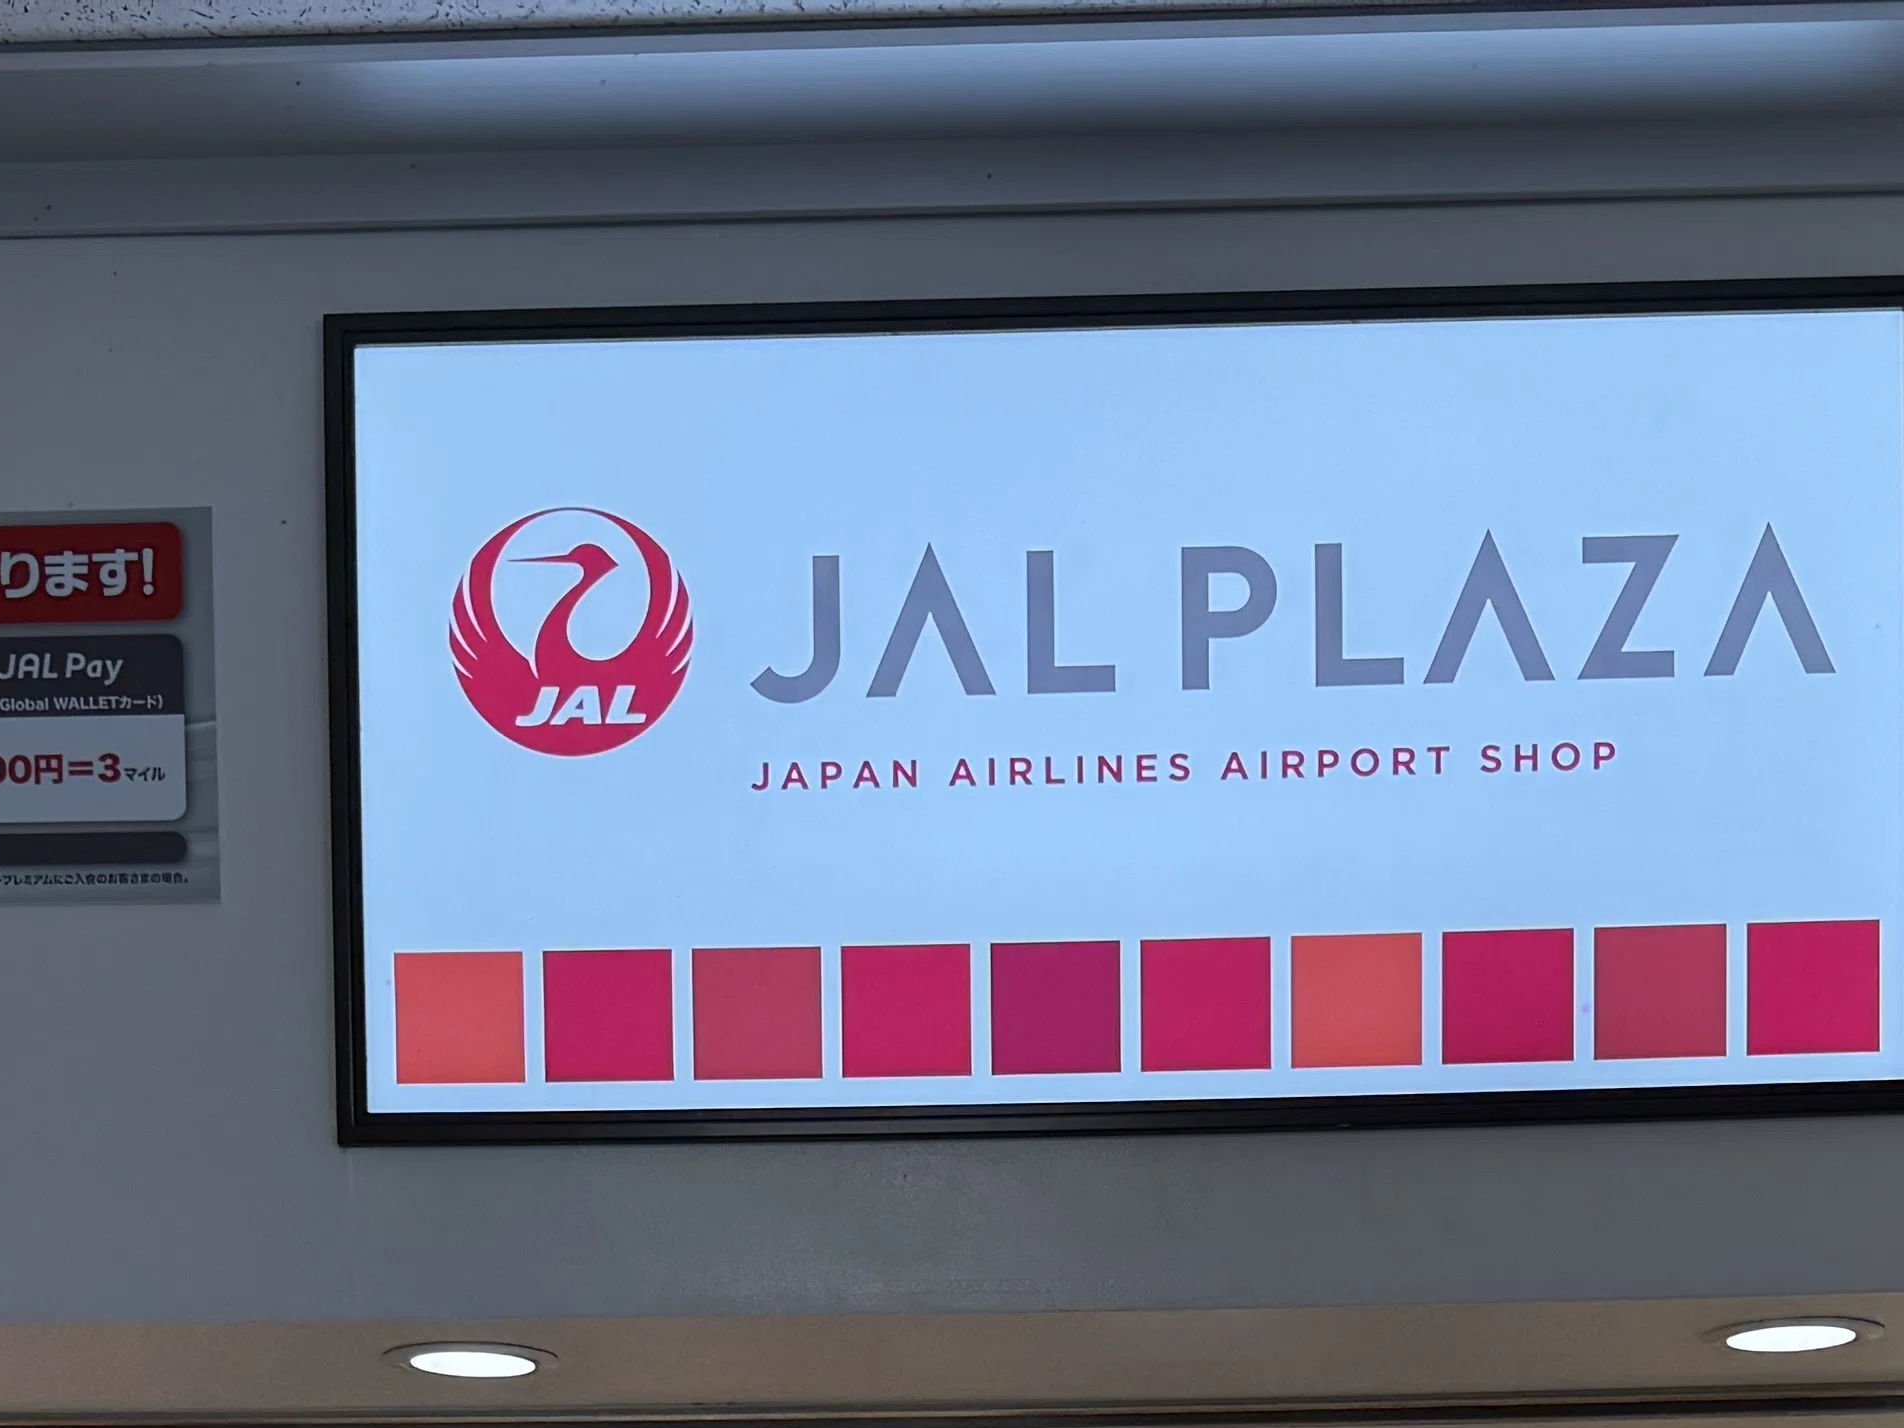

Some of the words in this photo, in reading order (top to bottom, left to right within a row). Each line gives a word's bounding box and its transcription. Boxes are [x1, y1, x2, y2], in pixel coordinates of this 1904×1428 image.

[750, 540, 1117, 704] JAL
[1182, 521, 1837, 690] PLAZA
[64, 652, 124, 686] Pay
[3, 695, 49, 713] Global
[515, 685, 647, 728] JAL
[751, 758, 922, 790] JAPAN
[949, 752, 1194, 787] AIRLINES
[1222, 745, 1453, 781] AIRPORT
[1479, 740, 1619, 774] SHOP
